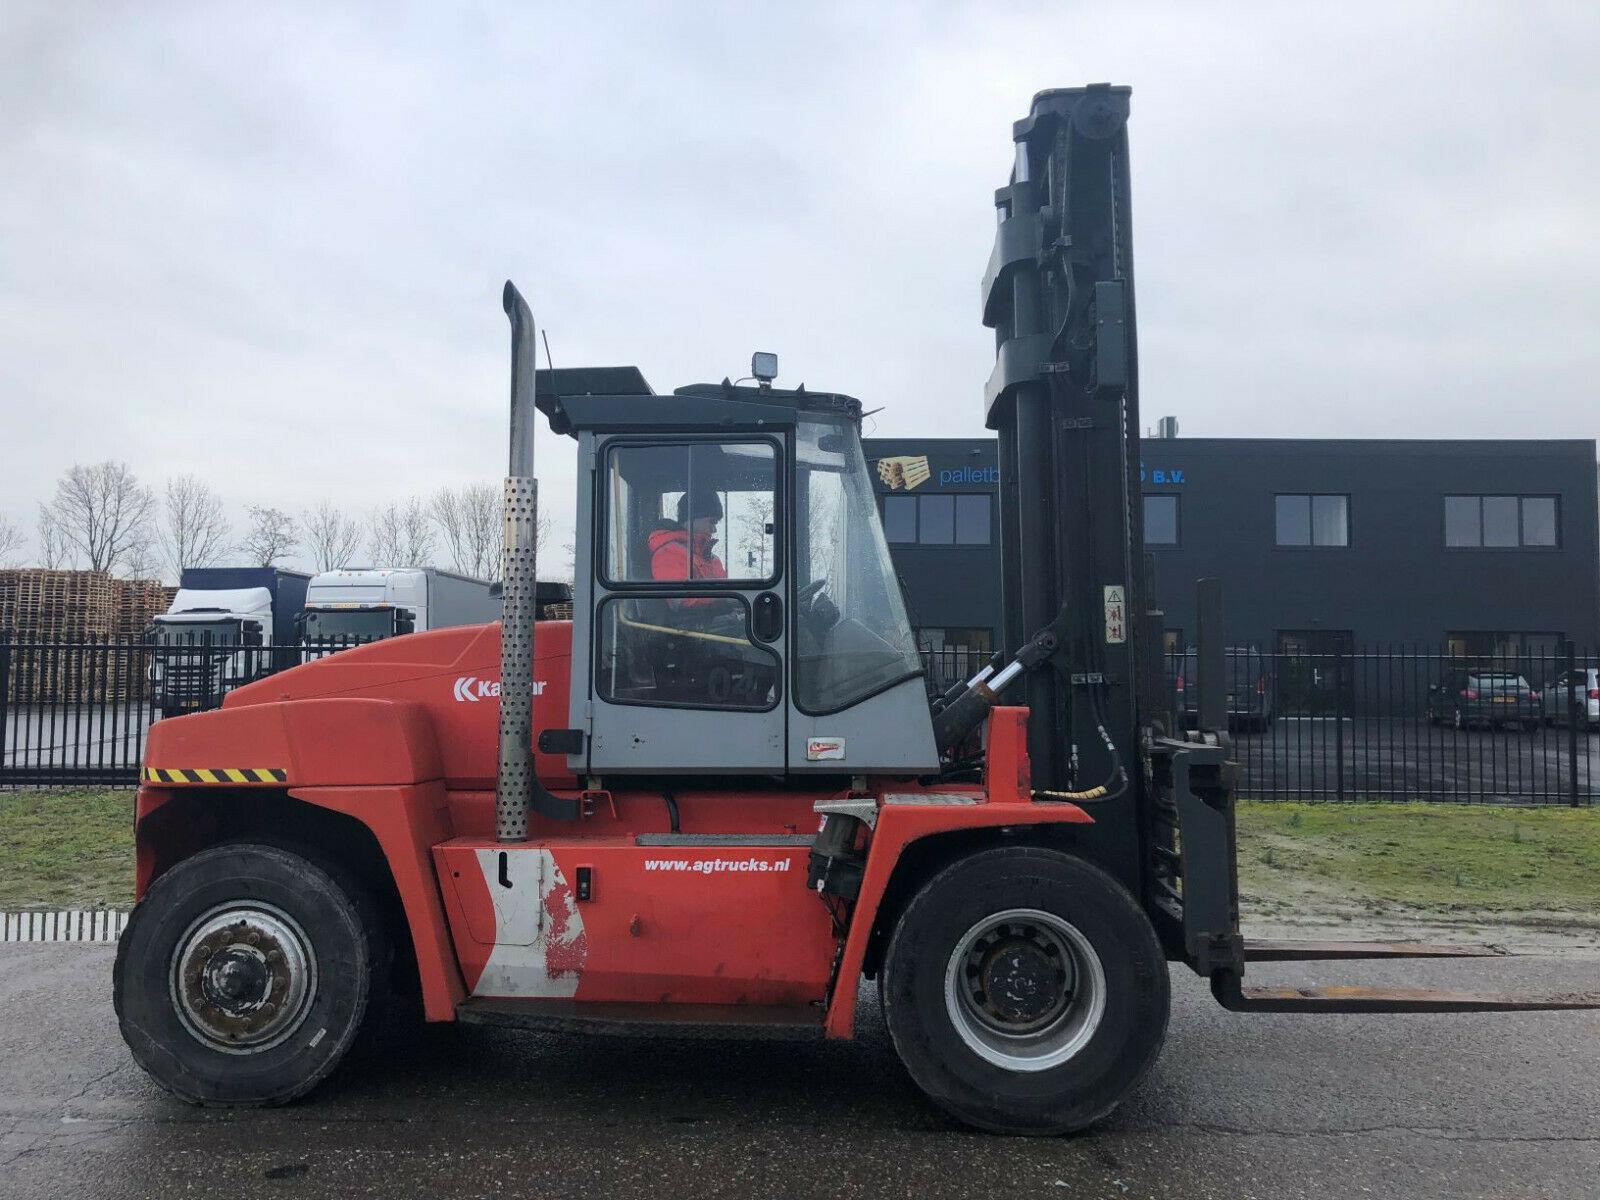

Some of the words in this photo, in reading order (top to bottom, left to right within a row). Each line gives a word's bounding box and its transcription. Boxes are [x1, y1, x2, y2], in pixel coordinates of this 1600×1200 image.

[940, 466, 999, 486] palletb
[1152, 470, 1185, 483] B.V.
[478, 680, 547, 697] Kar
[644, 858, 790, 874] www.agtrucks.nl
